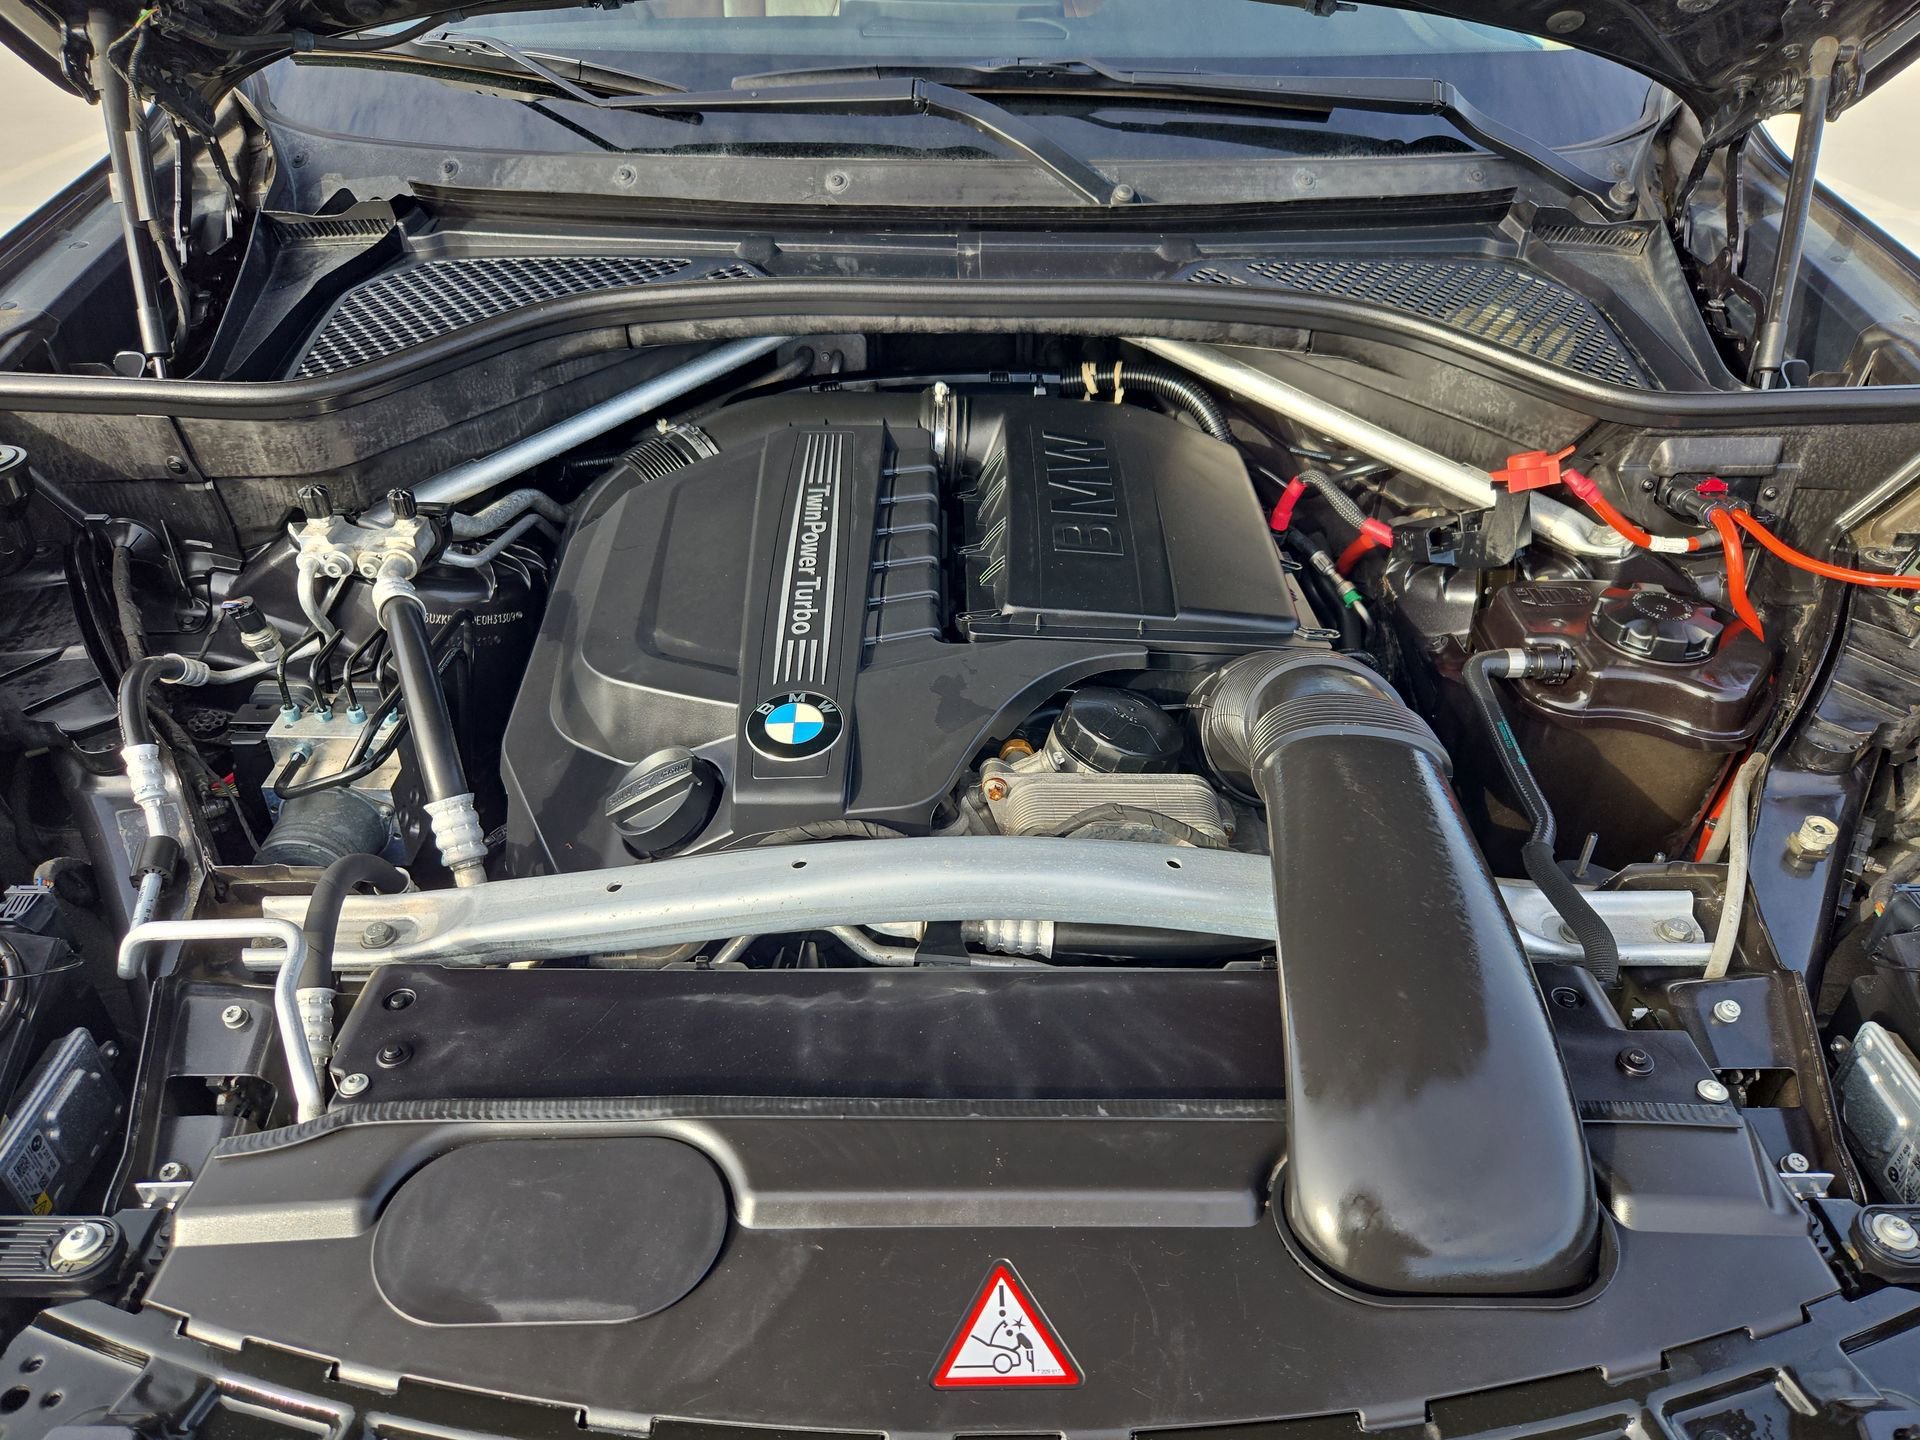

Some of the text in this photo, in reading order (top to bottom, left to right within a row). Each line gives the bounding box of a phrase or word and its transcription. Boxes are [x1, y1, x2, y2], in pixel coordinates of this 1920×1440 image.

[1042, 429, 1124, 556] BMW
[791, 484, 831, 635] TwinPower Turbo
[756, 692, 837, 716] BMW
